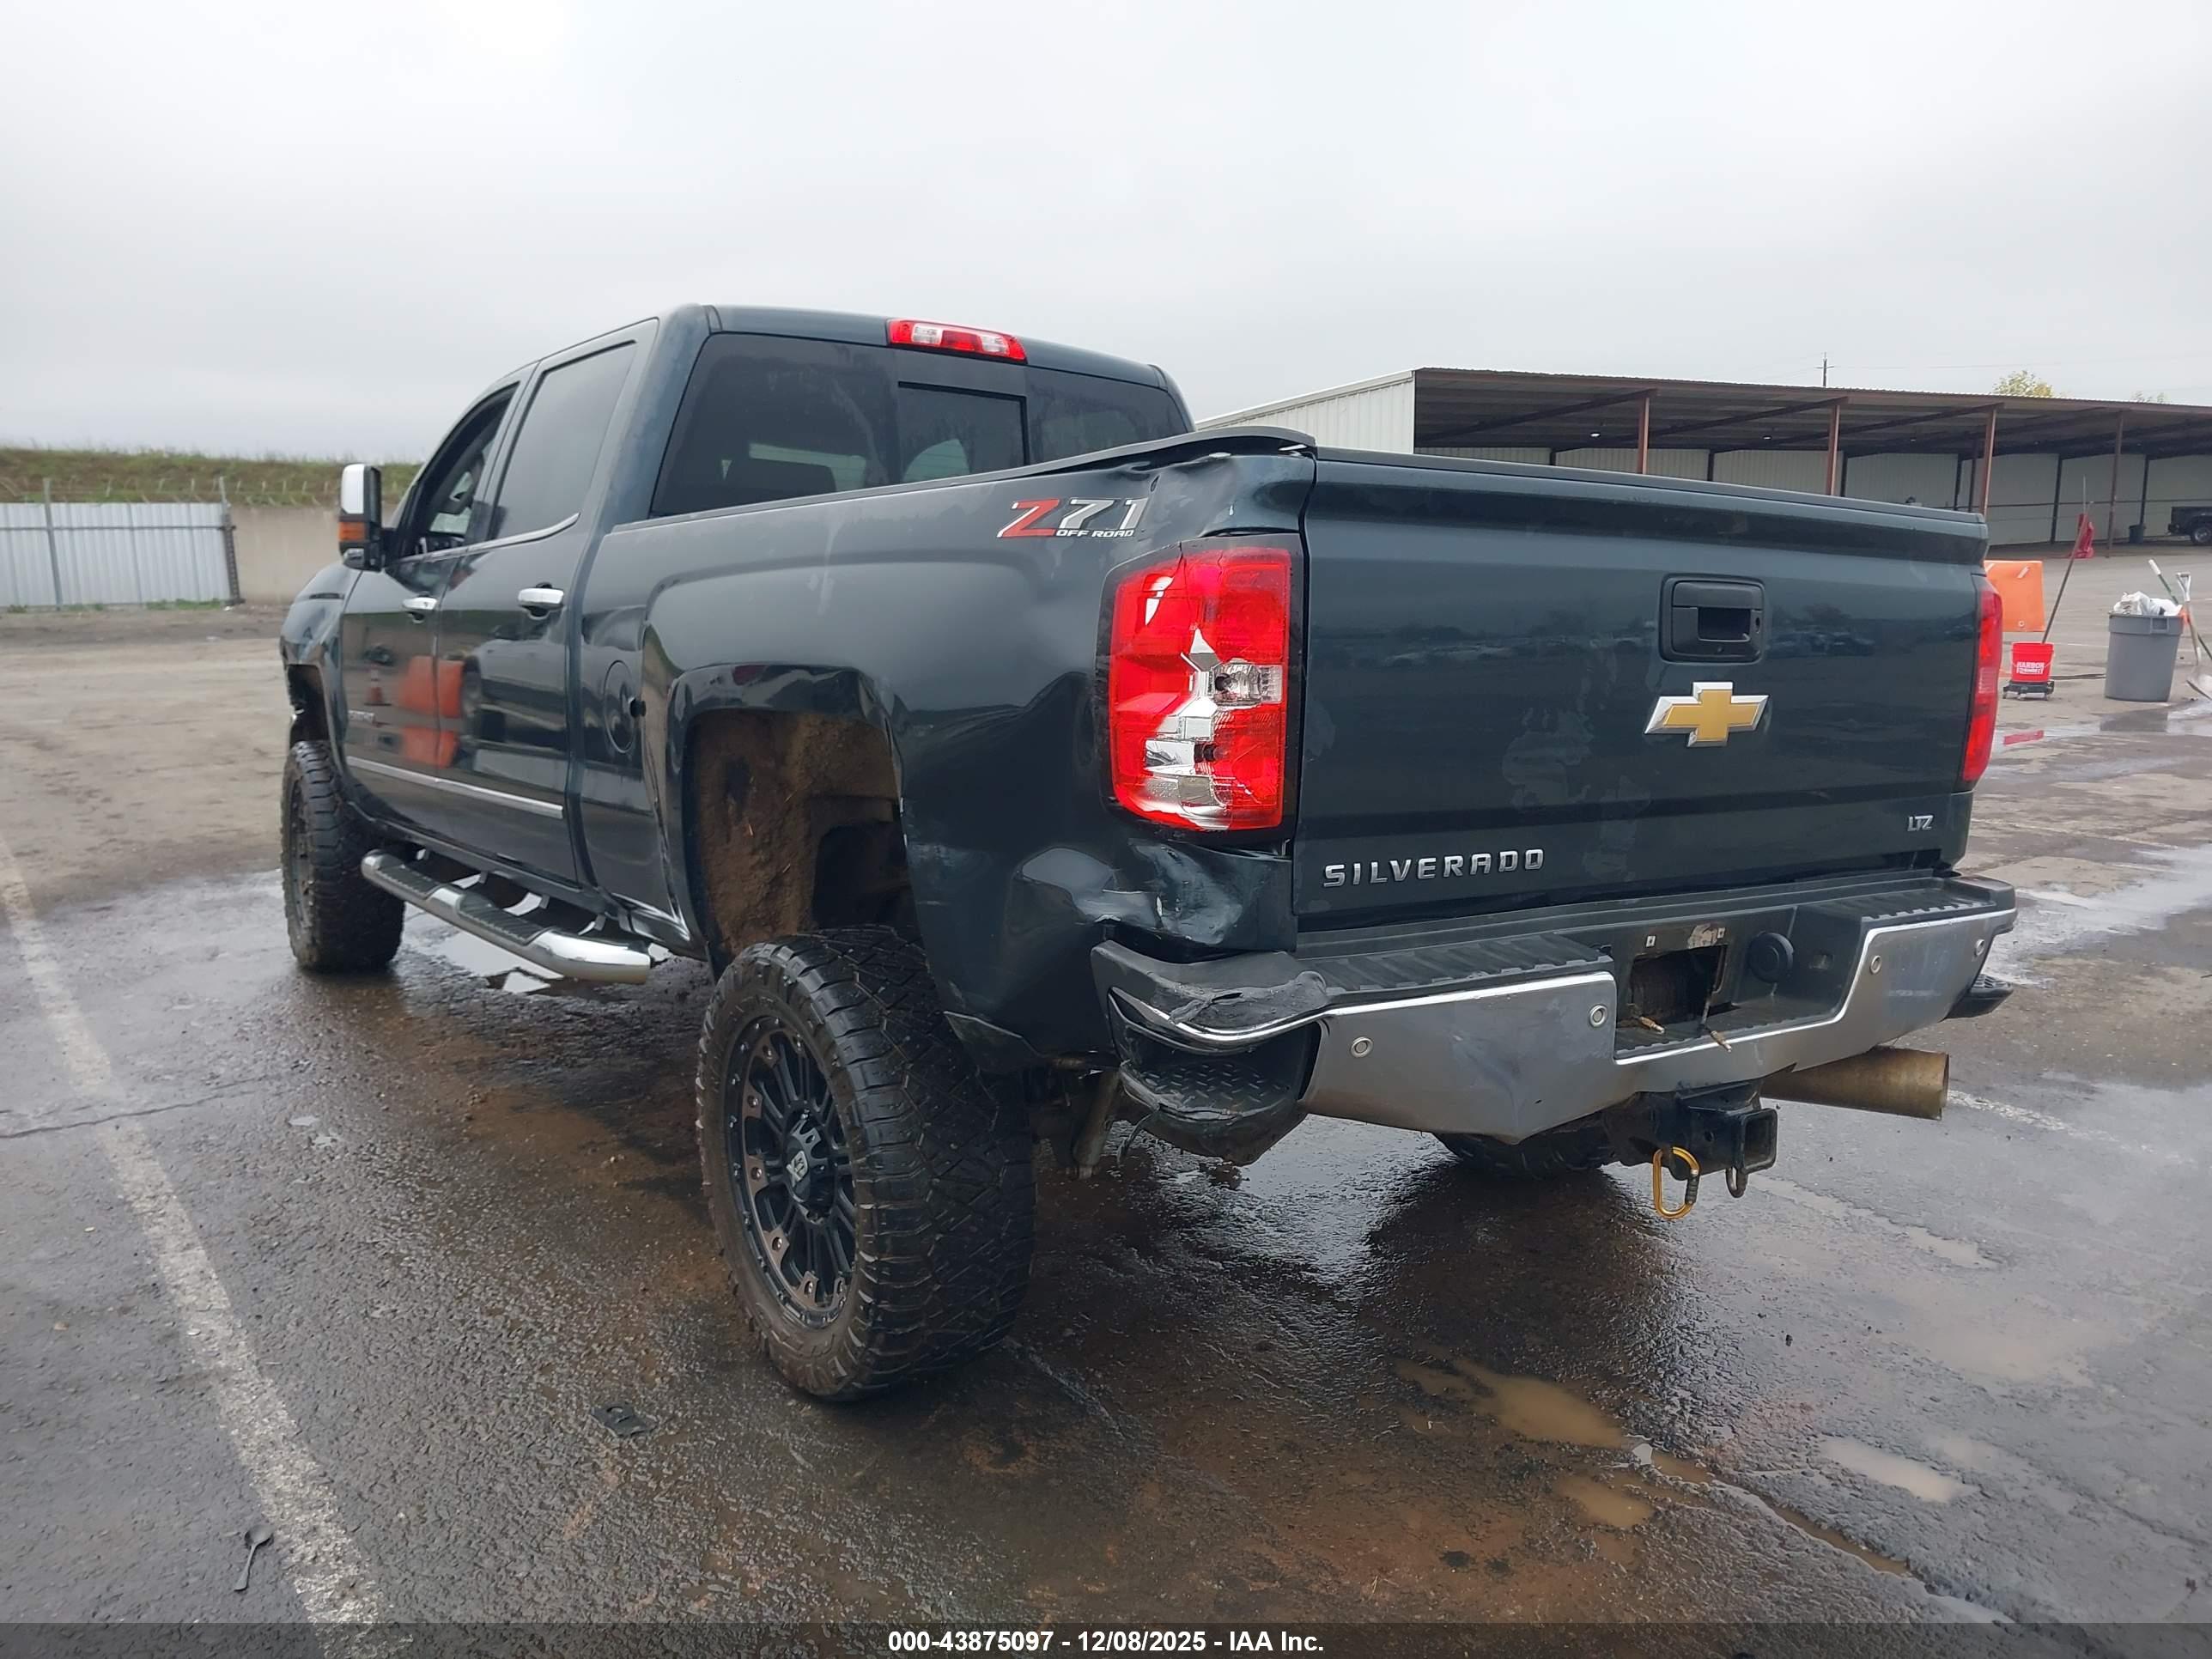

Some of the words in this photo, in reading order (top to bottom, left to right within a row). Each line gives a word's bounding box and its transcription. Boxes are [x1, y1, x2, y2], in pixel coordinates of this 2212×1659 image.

[997, 497, 1149, 538] Z71
[1055, 529, 1089, 538] OFF
[1091, 529, 1135, 538] ROAD
[1907, 815, 1934, 832] LTZ
[1323, 848, 1544, 887] SILVERADO
